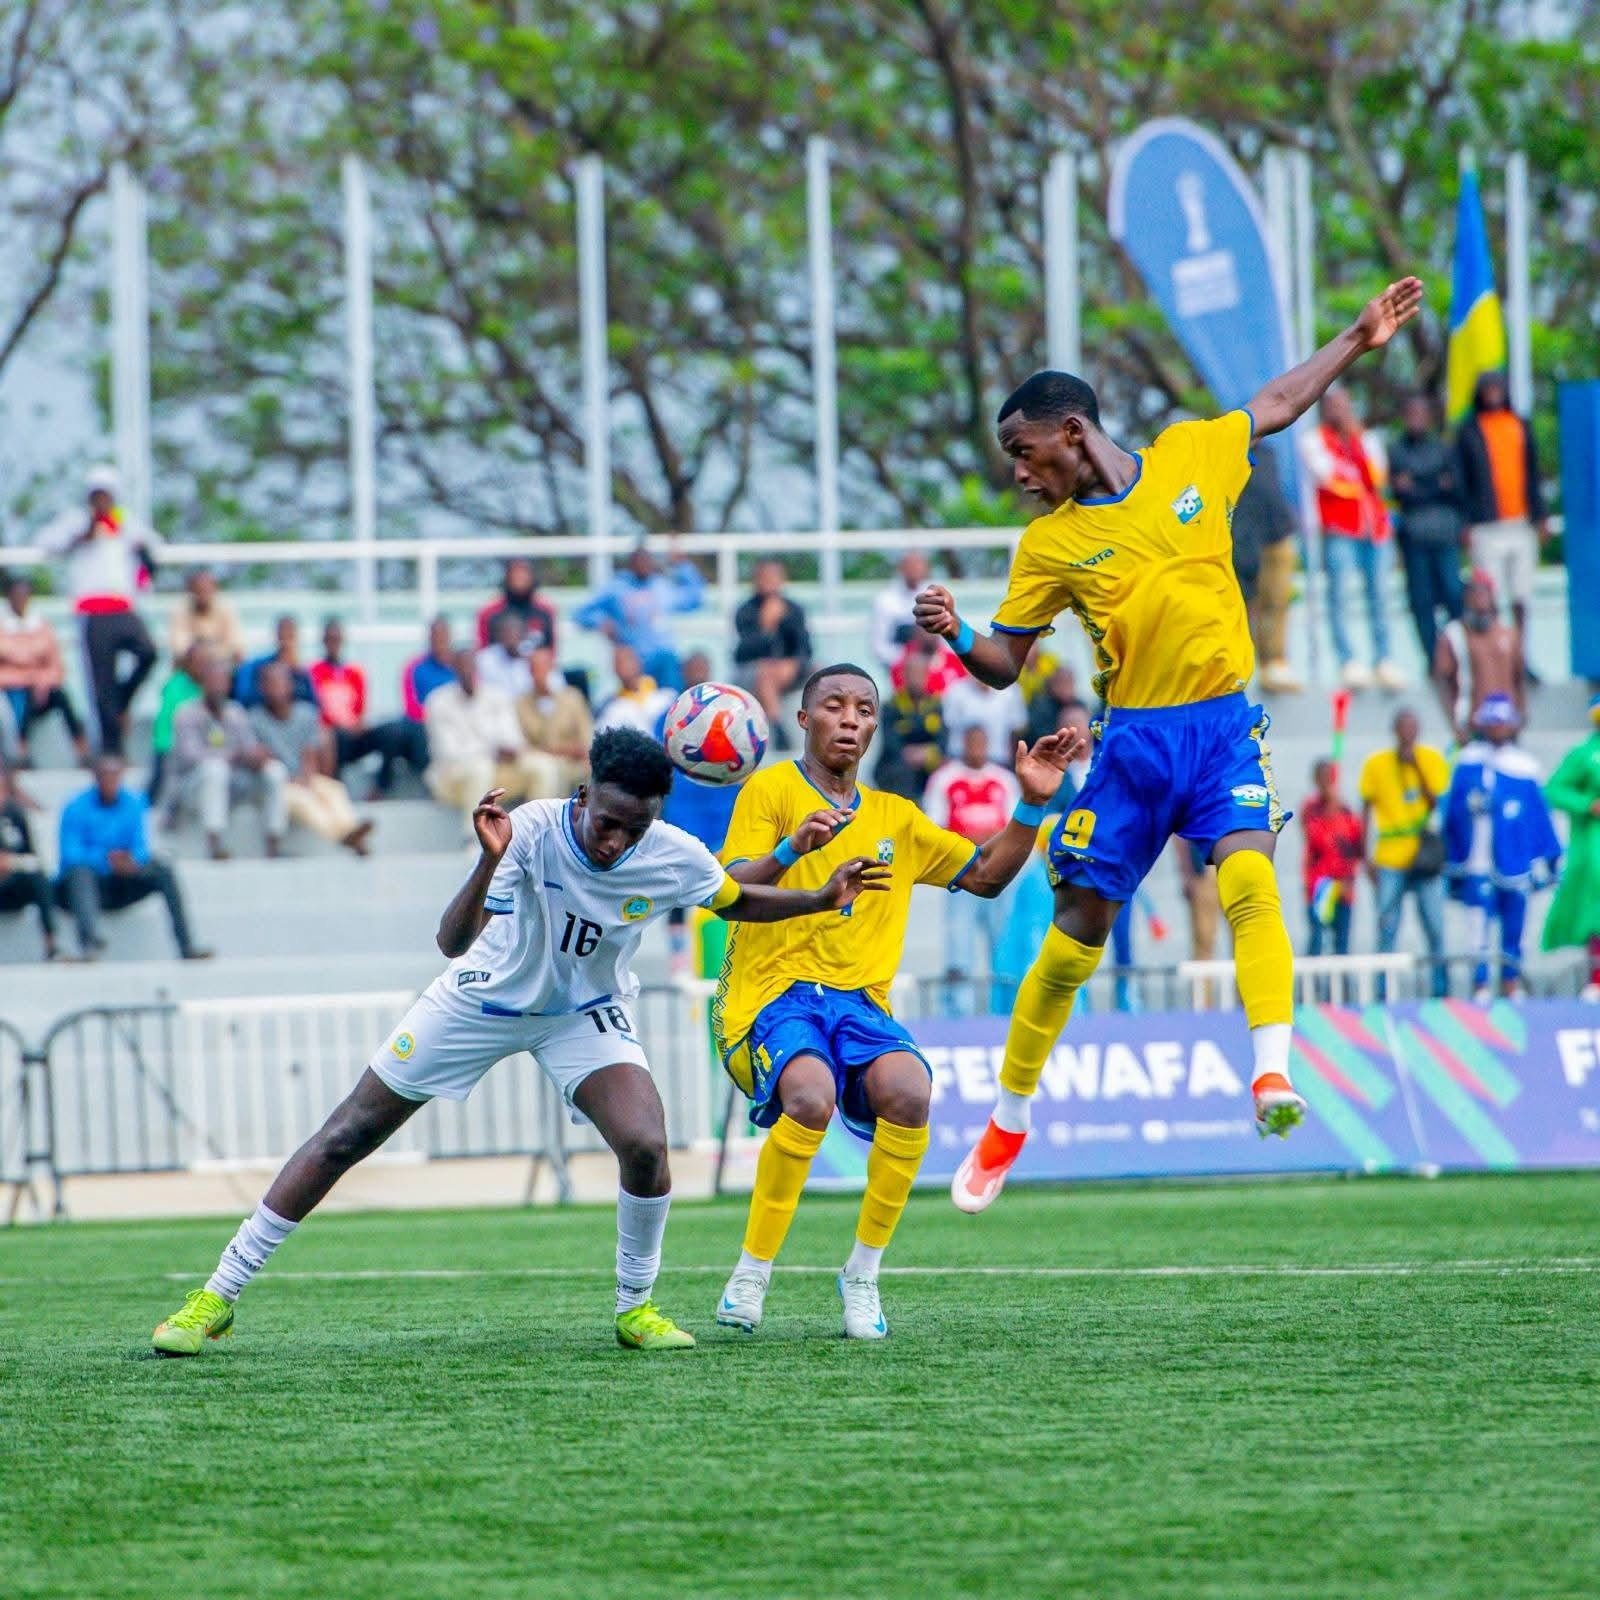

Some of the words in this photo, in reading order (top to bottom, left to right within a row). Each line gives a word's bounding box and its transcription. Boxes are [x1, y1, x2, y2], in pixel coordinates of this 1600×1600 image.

[1061, 808, 1097, 849] 9
[560, 911, 602, 956] 16
[920, 1040, 1242, 1103] FEWAFA
